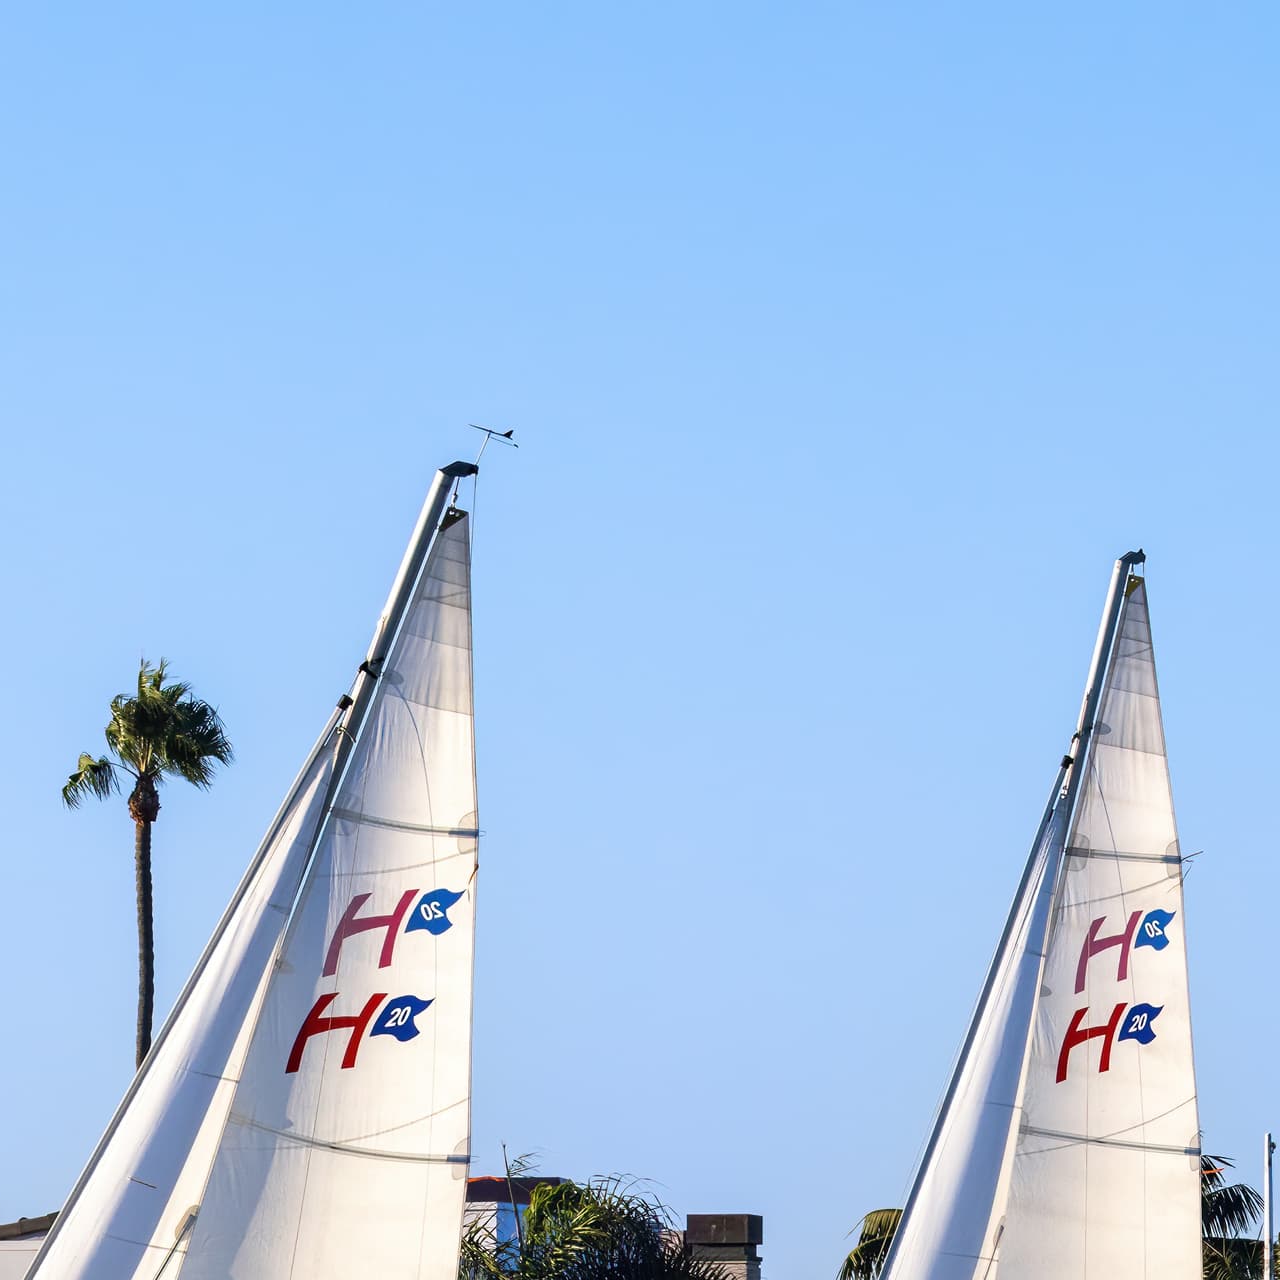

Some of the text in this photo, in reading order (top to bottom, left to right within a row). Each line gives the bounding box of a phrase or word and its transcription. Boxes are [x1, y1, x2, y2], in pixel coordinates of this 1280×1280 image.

[285, 992, 411, 1073] H 20
[1056, 1002, 1148, 1084] H 20
